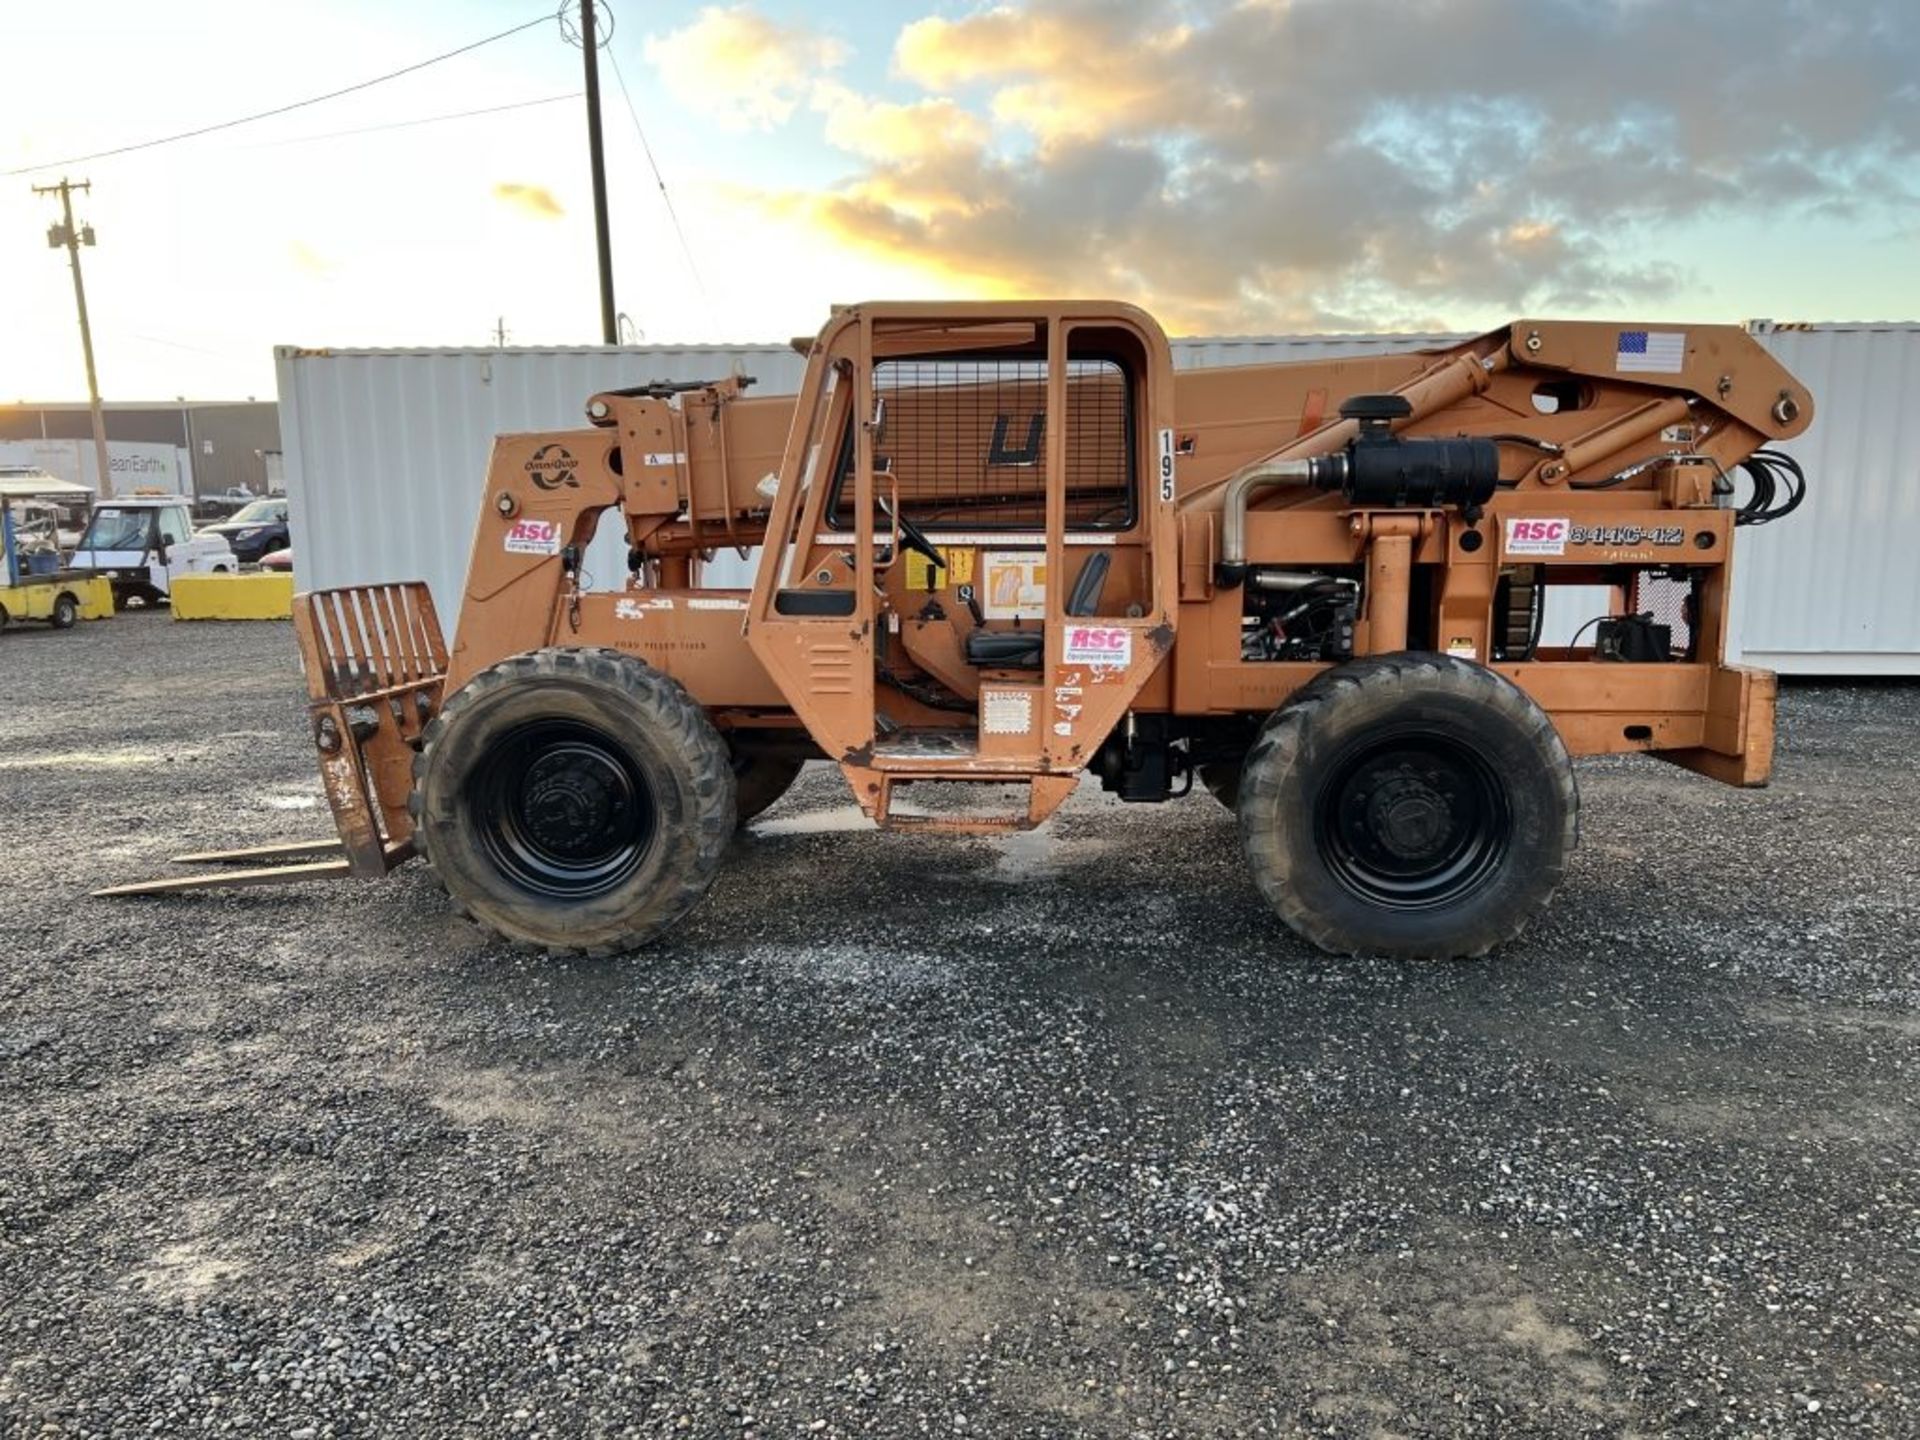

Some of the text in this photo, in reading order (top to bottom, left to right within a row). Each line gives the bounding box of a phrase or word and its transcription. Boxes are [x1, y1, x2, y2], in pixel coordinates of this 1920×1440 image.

[111, 454, 160, 472] eanEarth
[1162, 431, 1172, 500] 195
[1513, 522, 1563, 540] RSC
[1071, 629, 1126, 649] RSC
